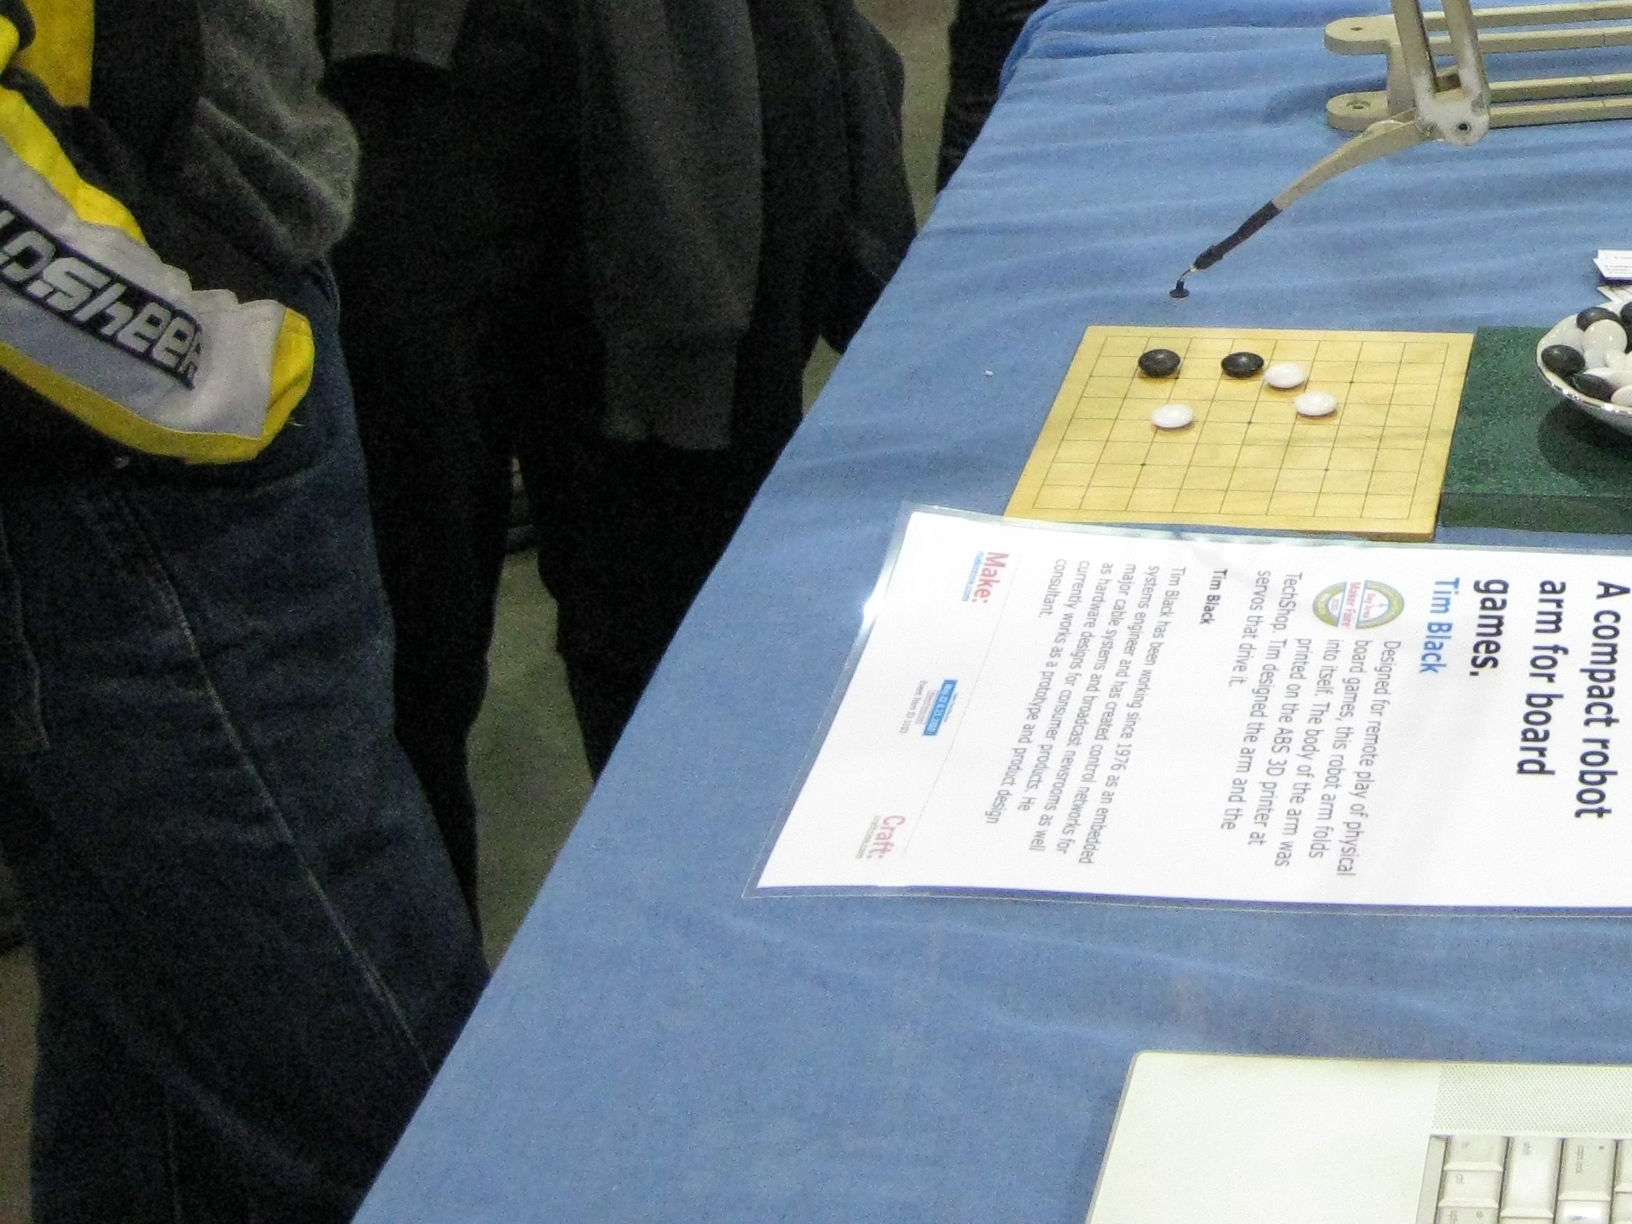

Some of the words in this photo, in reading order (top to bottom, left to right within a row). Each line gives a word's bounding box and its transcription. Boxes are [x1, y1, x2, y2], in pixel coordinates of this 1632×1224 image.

[972, 552, 1008, 603] Make:
[1099, 562, 1113, 574] as
[1117, 564, 1135, 595] major
[1167, 567, 1186, 586] Tim
[1208, 568, 1227, 590] Tim
[1038, 559, 1066, 617] consultant.
[1062, 560, 1089, 609] currently
[1136, 565, 1159, 608] systems
[1248, 570, 1270, 610] servos
[1429, 577, 1459, 613] Tim
[1596, 581, 1630, 599] A
[1083, 578, 1110, 628] hardware
[1107, 599, 1125, 626] cable
[1159, 590, 1179, 617] Black
[1199, 594, 1220, 624] Black
[1270, 572, 1302, 633] TechShop.
[1534, 580, 1565, 633] arm
[1053, 612, 1073, 643] works
[1123, 611, 1146, 656] engineer
[1151, 621, 1171, 638] has
[1241, 615, 1263, 638] that
[1469, 579, 1508, 676] games.
[1048, 646, 1063, 658] as
[1068, 631, 1093, 669] designs
[1092, 629, 1117, 670] systems
[1143, 642, 1163, 665] been
[1231, 642, 1255, 672] drive
[1265, 638, 1287, 659] Tim
[1288, 638, 1312, 679] printed
[1322, 639, 1343, 661] into
[1348, 639, 1372, 673] board
[1418, 622, 1452, 673] Black
[1114, 659, 1131, 677] and
[1373, 640, 1401, 694] Designed
[1528, 644, 1568, 683] for
[1579, 610, 1620, 727] compact
[1064, 672, 1081, 686] for
[1085, 673, 1102, 691] and
[1107, 681, 1127, 698] has
[1125, 669, 1151, 708] working
[1228, 676, 1247, 687] it.
[1249, 663, 1278, 717] designed
[1284, 683, 1300, 698] on
[1314, 665, 1337, 696] itself.
[1025, 671, 1054, 720] prototype
[1335, 677, 1360, 721] games,
[1369, 699, 1390, 716] for
[1044, 689, 1071, 740] consumer
[1065, 695, 1097, 746] broadcast
[1093, 701, 1117, 740] created
[1119, 711, 1140, 739] since
[1277, 703, 1298, 723] the
[1307, 702, 1330, 724] The
[1017, 723, 1035, 743] and
[1242, 722, 1264, 742] the
[1270, 727, 1293, 753] ABS
[1296, 729, 1324, 759] body
[1332, 726, 1353, 749] this
[1358, 721, 1380, 766] remote
[1516, 693, 1563, 775] board
[1000, 747, 1026, 786] product
[1023, 744, 1053, 791] products.
[1080, 744, 1103, 782] control
[1109, 743, 1131, 770] 1976
[1235, 747, 1255, 772] arm
[1265, 758, 1286, 776] 3D
[1295, 764, 1314, 778] of
[1322, 754, 1345, 789] robot
[1043, 750, 1075, 811] newsrooms
[1104, 774, 1119, 787] as
[1227, 777, 1247, 802] and
[1288, 782, 1311, 803] the
[1348, 771, 1374, 798] play
[1574, 738, 1617, 818] robot
[984, 789, 1011, 824] design
[1016, 797, 1036, 811] He
[1061, 786, 1089, 834] networks
[1100, 790, 1114, 803] an
[1253, 781, 1277, 827] printer
[1316, 793, 1336, 820] arm
[1349, 803, 1367, 818] of
[1037, 813, 1053, 826] as
[1219, 807, 1242, 829] the
[1283, 808, 1301, 835] arm
[865, 815, 905, 859] Craft:
[1028, 830, 1045, 851] well
[1055, 838, 1075, 854] for
[1077, 807, 1108, 864] embedded
[1247, 831, 1265, 845] at
[1308, 825, 1333, 858] folds
[1336, 821, 1363, 875] physical
[1274, 841, 1292, 866] was
